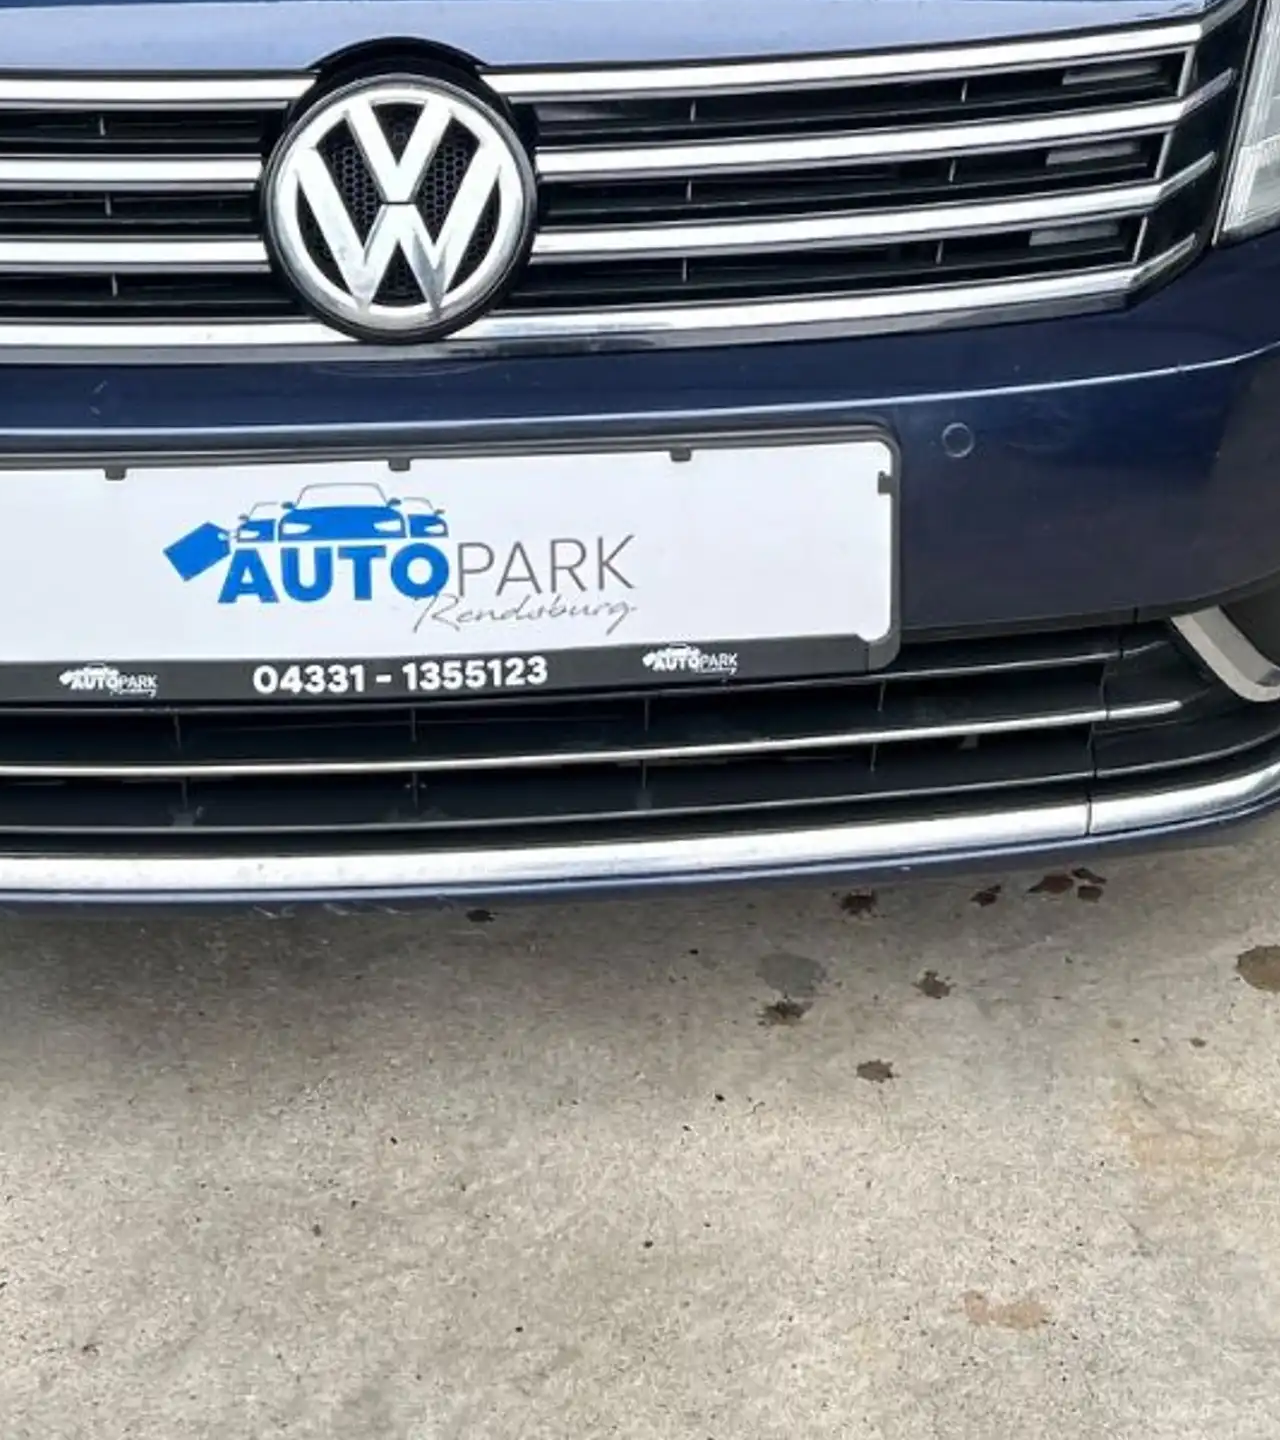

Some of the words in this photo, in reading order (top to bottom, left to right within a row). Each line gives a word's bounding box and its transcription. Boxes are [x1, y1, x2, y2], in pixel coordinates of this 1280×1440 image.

[275, 88, 523, 322] VW
[217, 534, 635, 604] AUTOPARK
[412, 589, 637, 636] Rendsburg
[70, 673, 158, 690] AUTOPARK
[252, 663, 366, 695] 04331
[375, 673, 392, 684] -
[401, 654, 549, 692] 1355123
[652, 652, 738, 672] AUTOPARK
